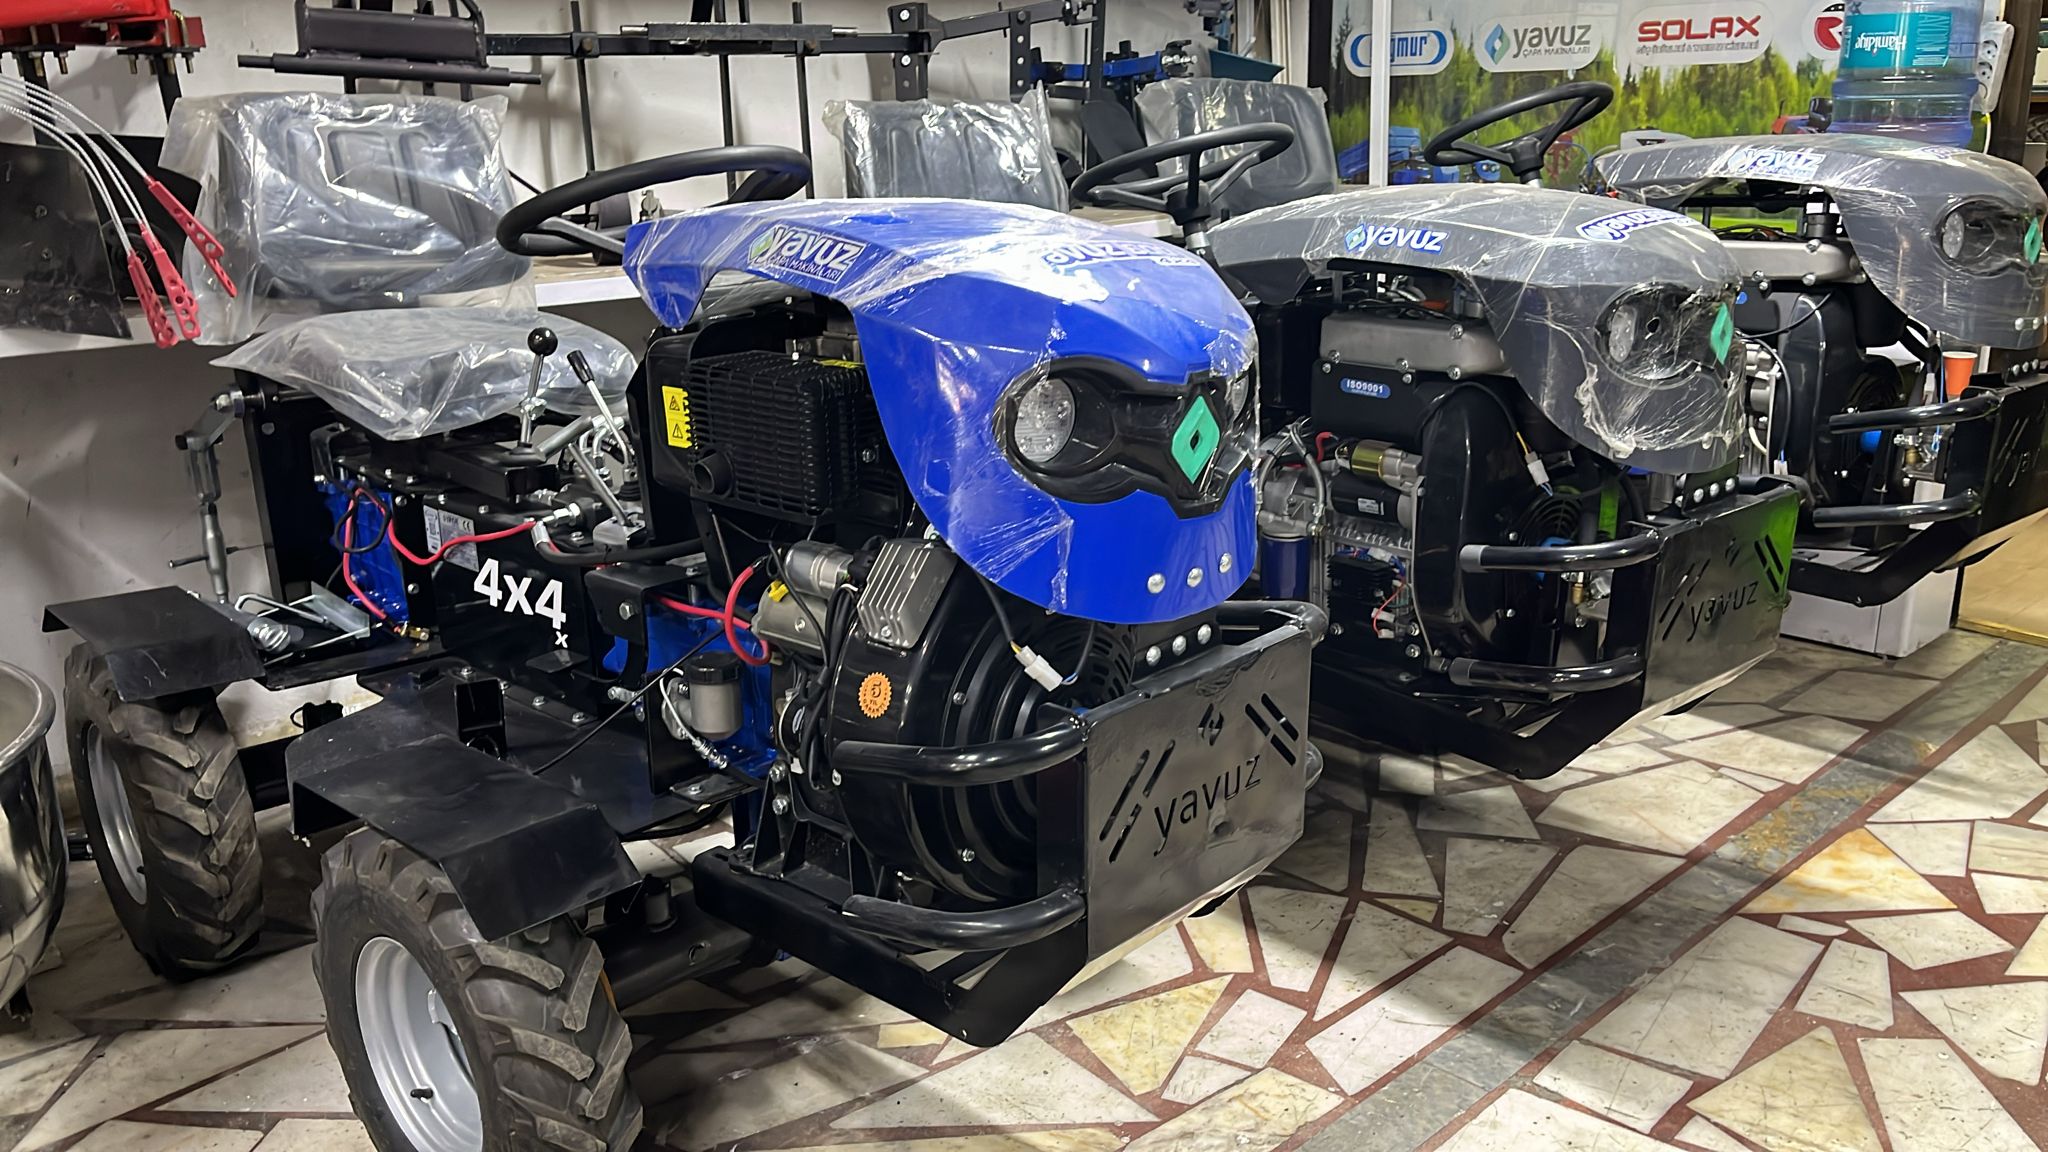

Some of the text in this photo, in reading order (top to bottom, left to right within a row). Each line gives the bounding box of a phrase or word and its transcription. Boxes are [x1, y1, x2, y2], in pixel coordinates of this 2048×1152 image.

[1513, 25, 1592, 58] yavuz
[1638, 15, 1761, 42] SOLAX
[755, 226, 862, 271] yavuz
[1358, 225, 1448, 252] yavuz
[1686, 581, 1759, 642] yavuz
[871, 681, 882, 698] 5
[1153, 754, 1261, 857] yavuz
